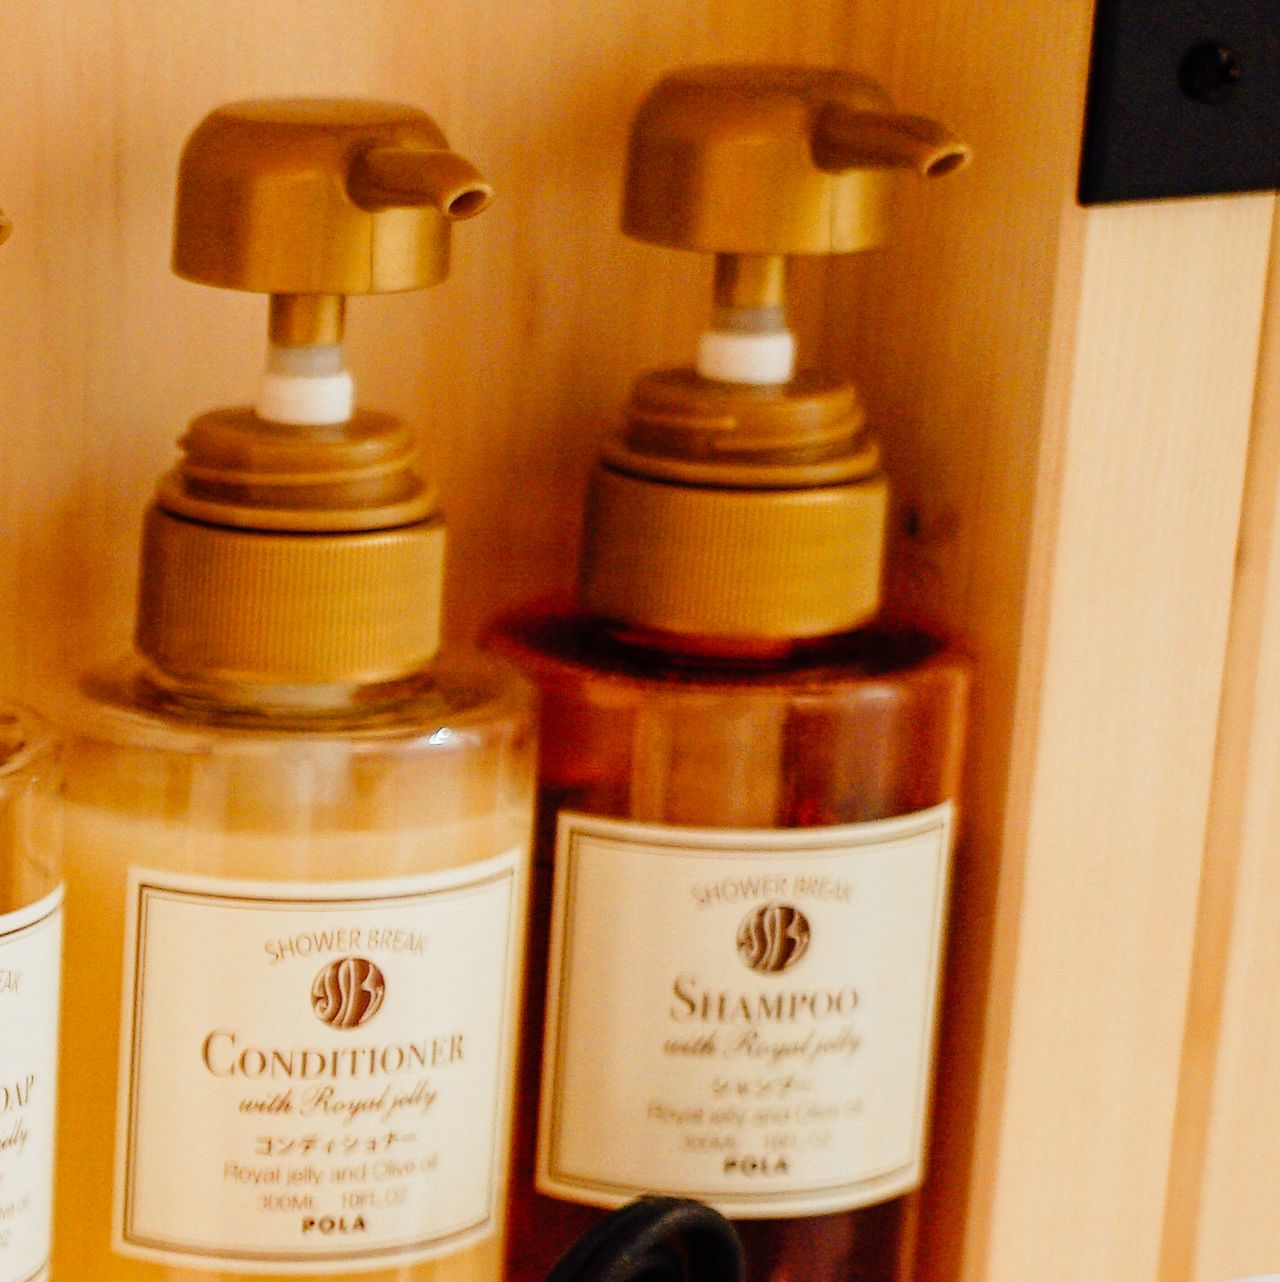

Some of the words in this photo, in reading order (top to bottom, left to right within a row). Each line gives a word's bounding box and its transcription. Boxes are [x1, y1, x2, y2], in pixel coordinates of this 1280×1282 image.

[264, 928, 361, 965] SHOWER
[367, 928, 428, 956] BREAK
[670, 975, 860, 1023] SHAMPOO
[201, 1027, 465, 1079] CONDITIONER
[238, 1088, 294, 1115] with
[299, 1082, 392, 1126] Royal
[380, 1077, 437, 1123] jelly
[223, 1159, 280, 1186] Royal
[330, 1162, 367, 1184] and
[722, 1155, 790, 1177] POLA
[301, 1216, 367, 1235] POLA
